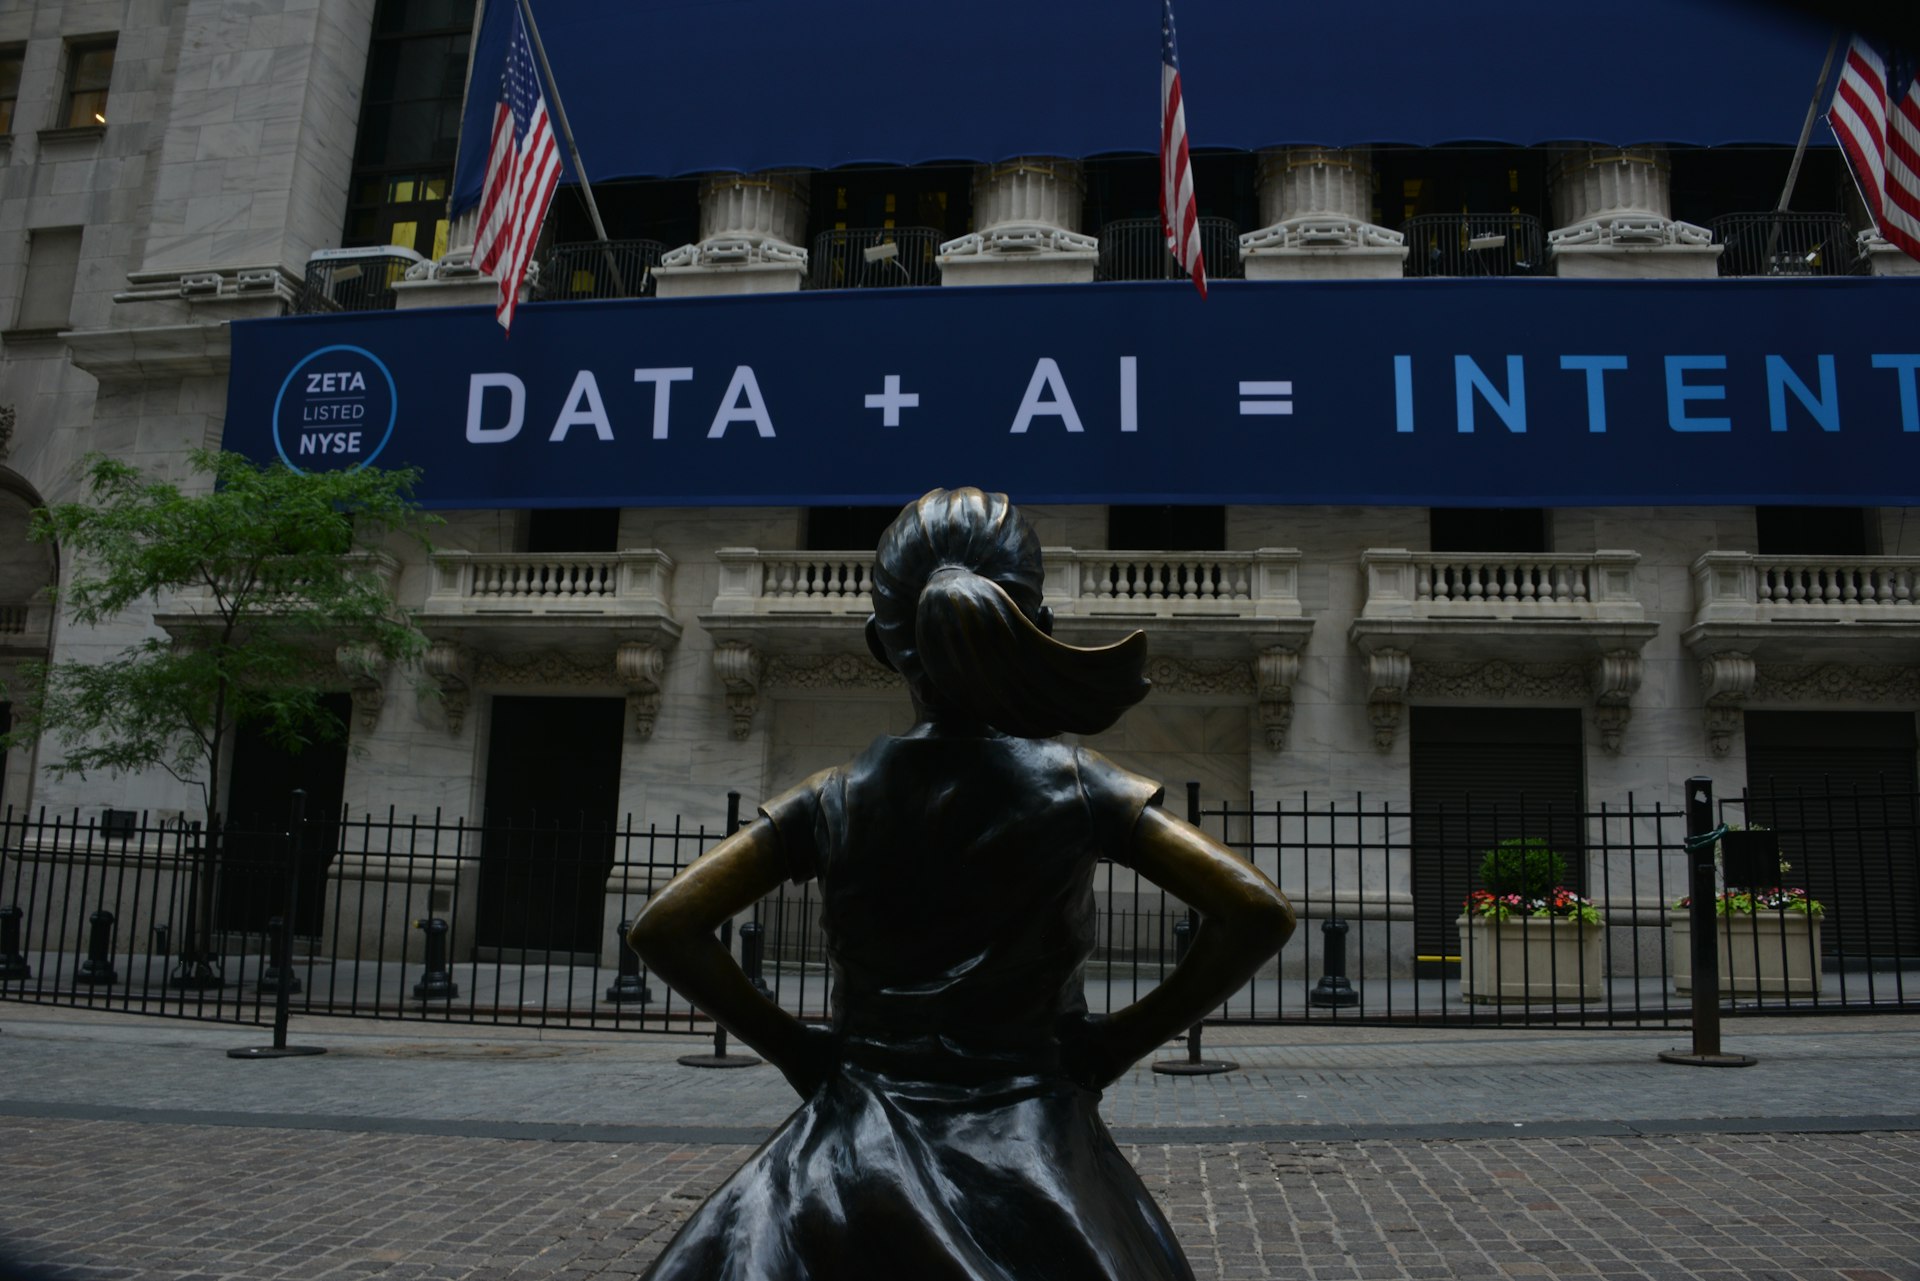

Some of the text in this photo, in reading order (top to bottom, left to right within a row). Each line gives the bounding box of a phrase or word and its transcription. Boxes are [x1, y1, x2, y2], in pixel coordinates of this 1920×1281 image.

[306, 371, 366, 393] ZETA
[465, 354, 1920, 444] DATA + AI = INTENT
[302, 403, 365, 421] LISTED
[299, 431, 362, 455] NYSE
